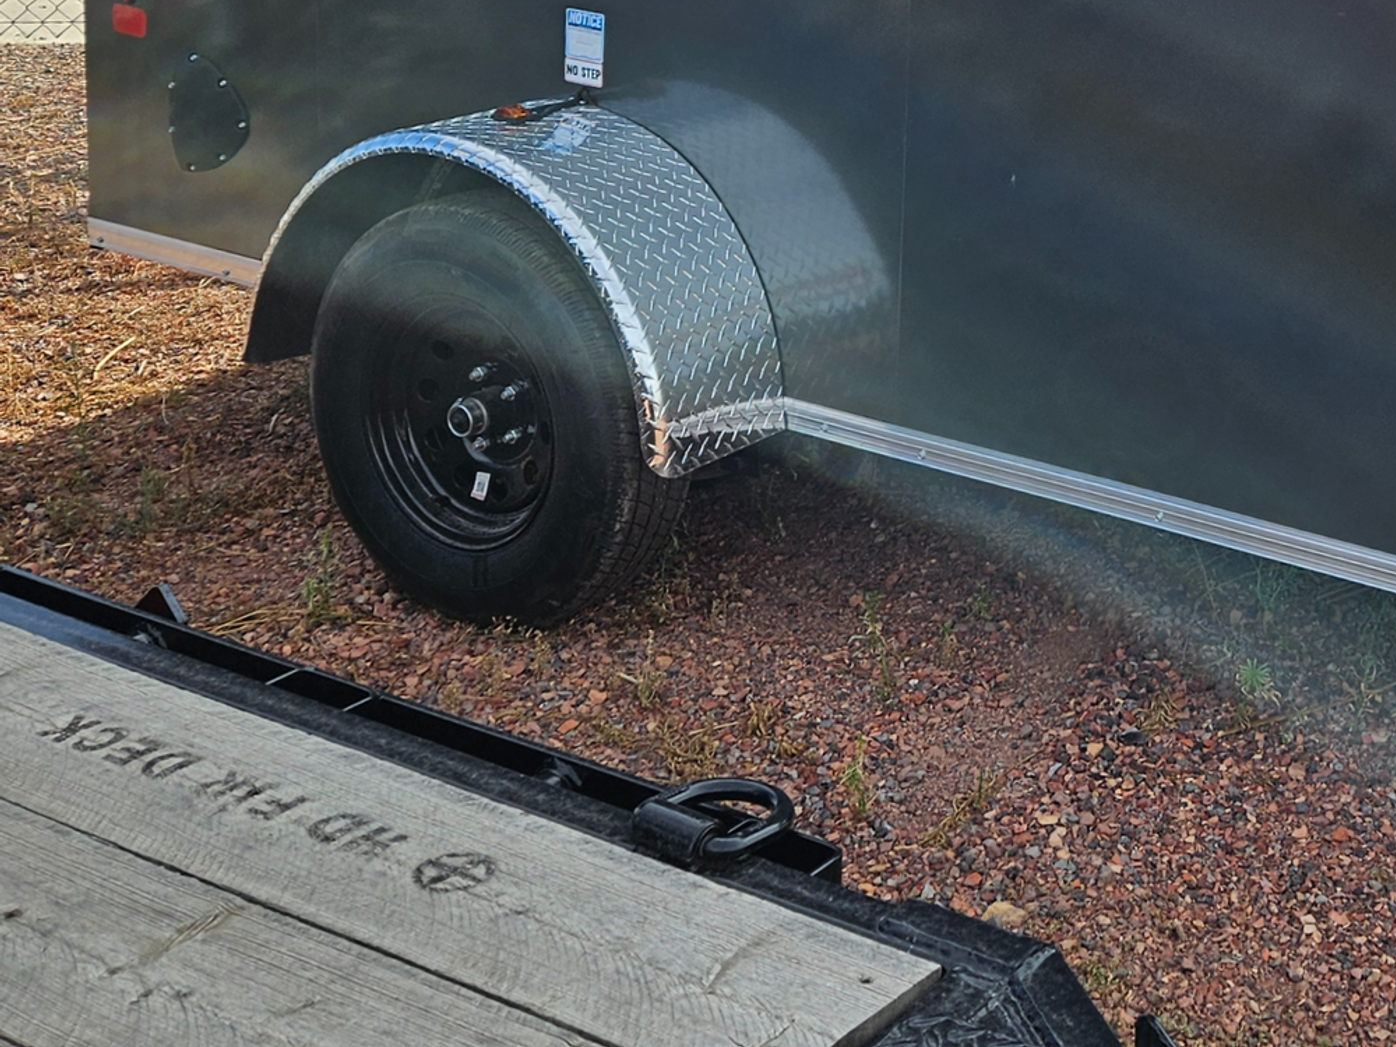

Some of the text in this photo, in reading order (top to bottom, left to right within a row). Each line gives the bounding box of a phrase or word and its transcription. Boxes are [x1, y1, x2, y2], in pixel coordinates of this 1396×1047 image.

[568, 10, 603, 29] NOTICE
[566, 64, 602, 80] NO STEP
[34, 714, 204, 779] DECK
[307, 812, 408, 857] HD
